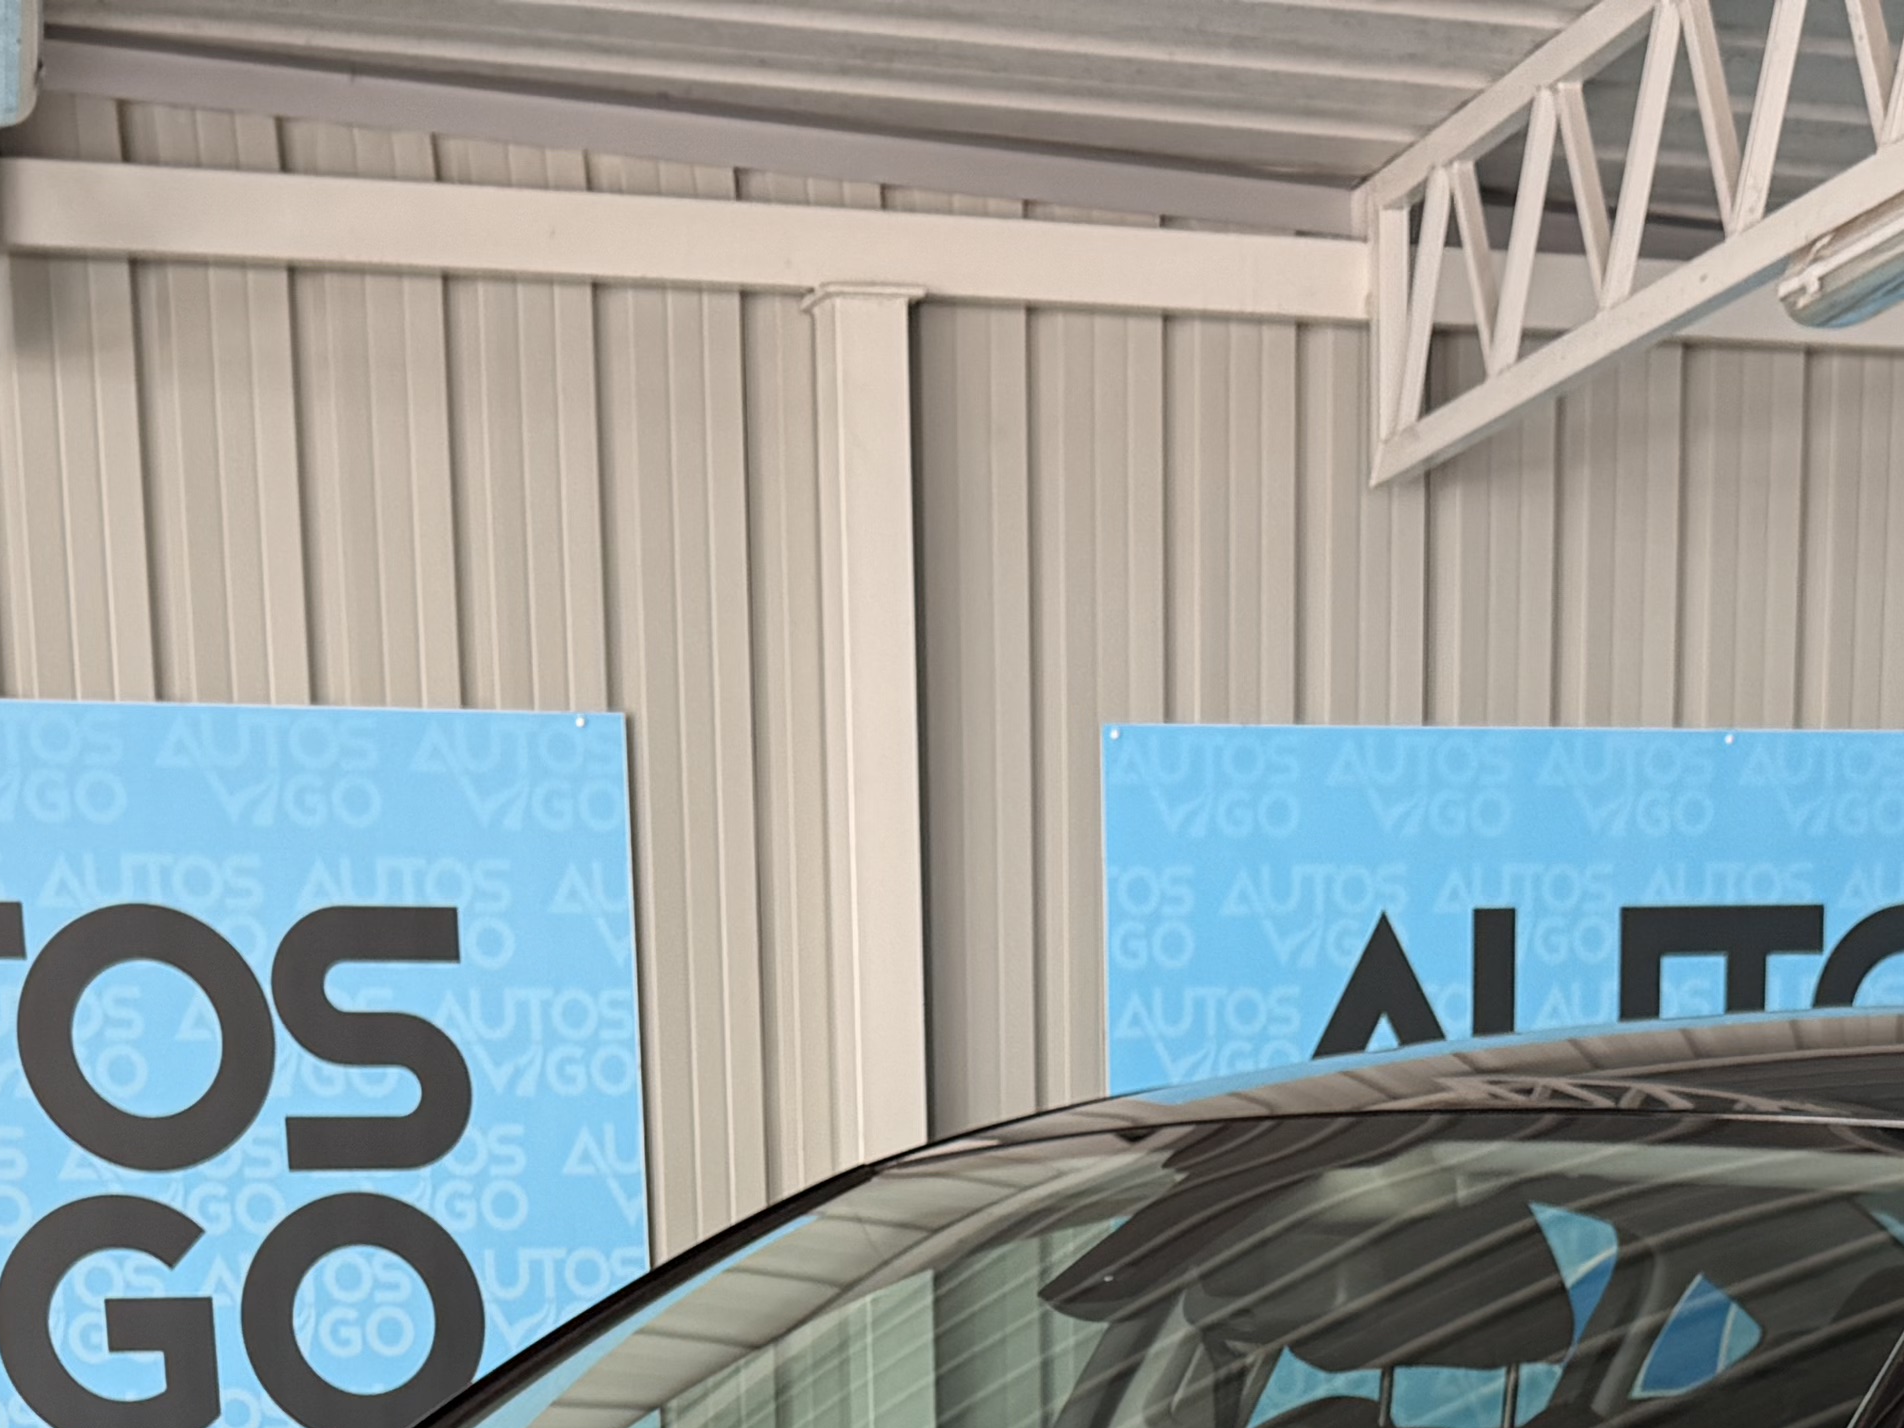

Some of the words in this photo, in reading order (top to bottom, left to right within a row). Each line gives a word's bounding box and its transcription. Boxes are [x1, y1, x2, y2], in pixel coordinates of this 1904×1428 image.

[154, 714, 380, 772] AUTOS
[406, 720, 624, 777] AUTOS
[202, 771, 383, 827] VIGO
[452, 776, 626, 831] VIGO
[36, 853, 264, 909] AUTOS
[294, 857, 514, 912] AUTOS
[1221, 864, 1407, 917] AUTOS
[1113, 985, 1301, 1040] AUTOS
[469, 1043, 640, 1096] VIGO
